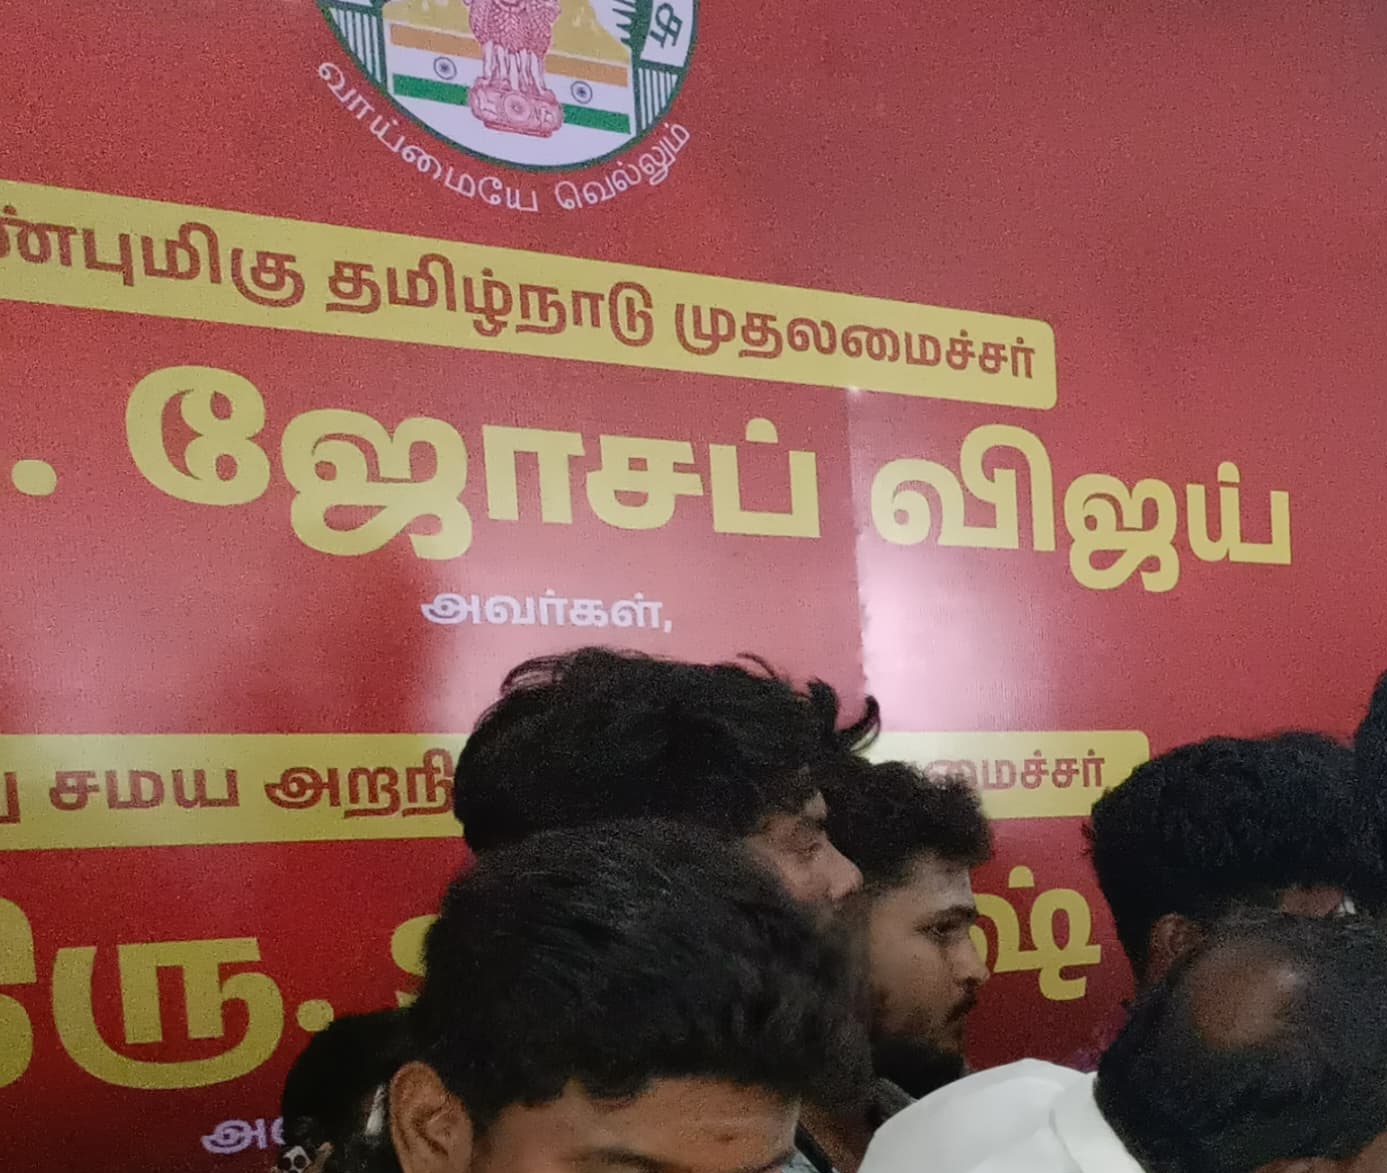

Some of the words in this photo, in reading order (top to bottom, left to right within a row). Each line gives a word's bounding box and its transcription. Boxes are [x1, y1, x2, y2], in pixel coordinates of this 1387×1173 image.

[317, 61, 539, 213] வாய்மையே
[554, 122, 691, 210] வெல்லும்
[326, 253, 655, 347] தமிழ்நாடு
[676, 302, 1037, 381] முதலமைச்சர்
[126, 365, 820, 560] ஜோசப்
[870, 423, 1292, 593] விஜய்
[421, 588, 673, 634] அவர்கள்,
[49, 768, 240, 812] சமய
[264, 748, 457, 820] அறநி
